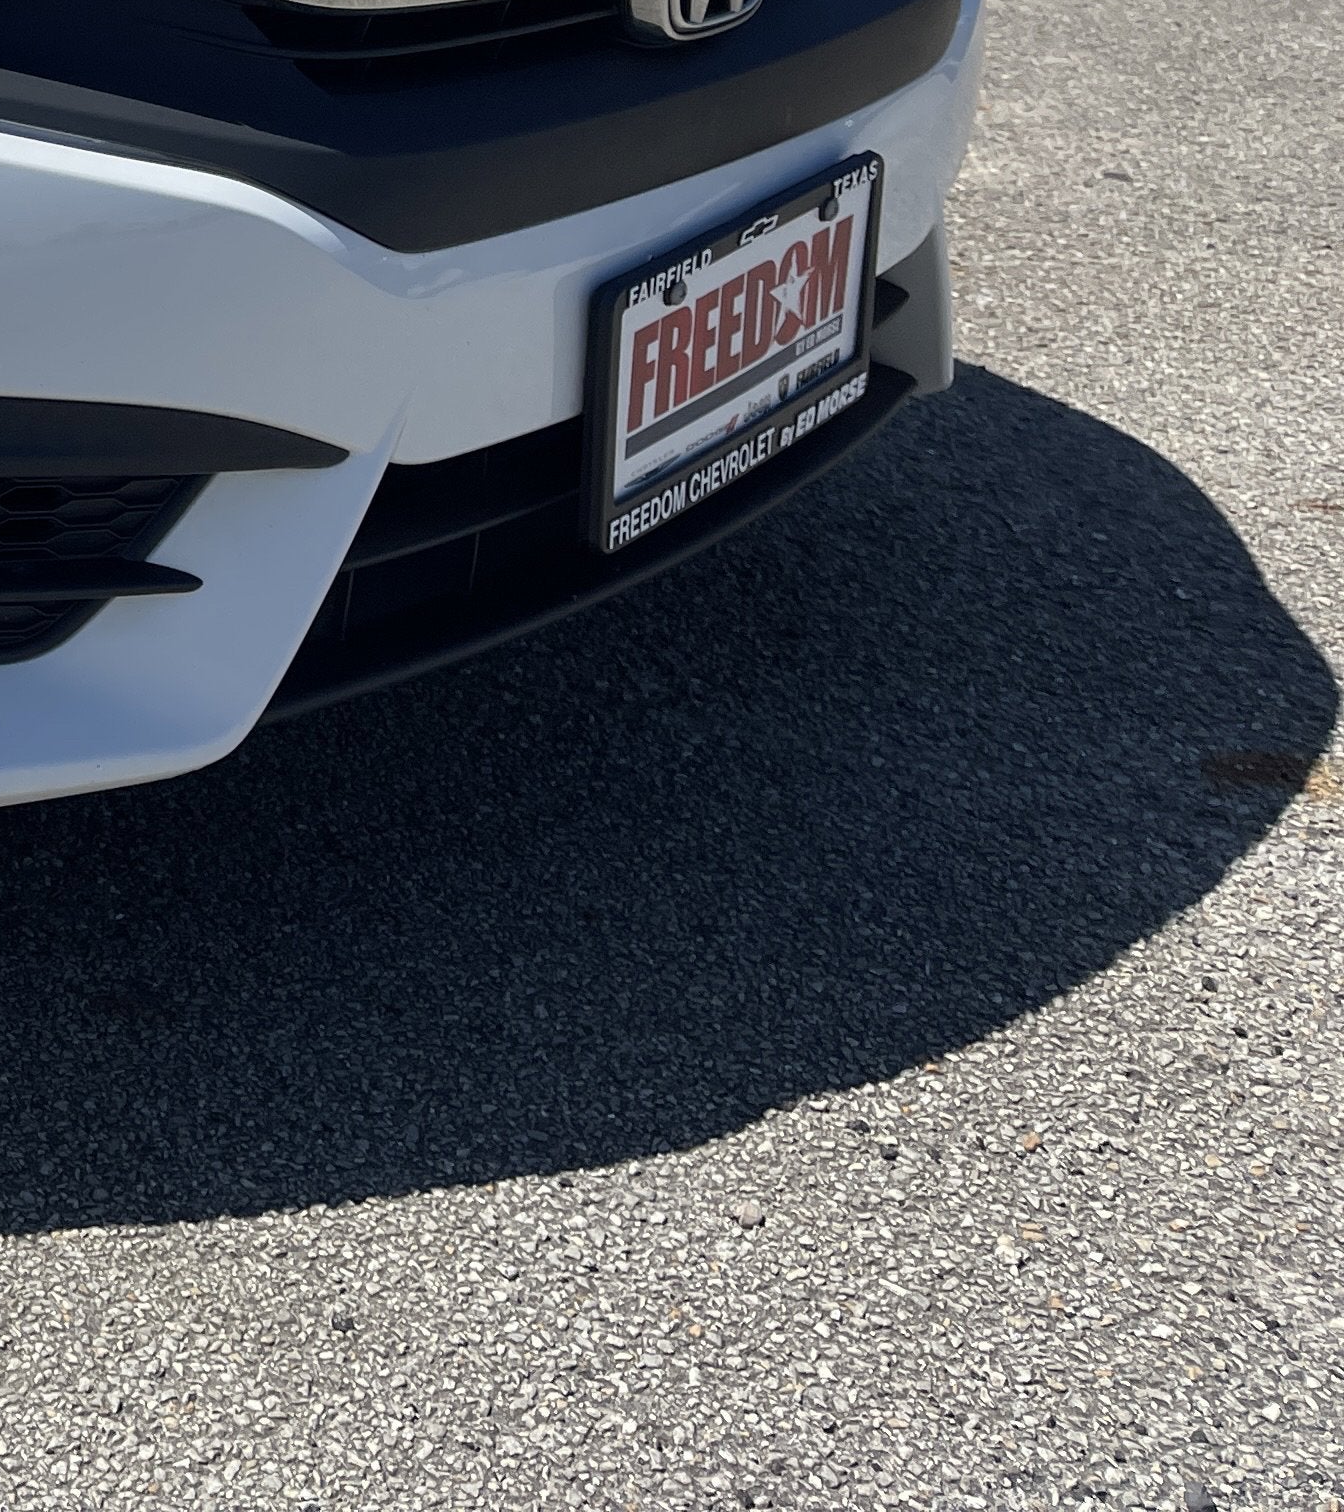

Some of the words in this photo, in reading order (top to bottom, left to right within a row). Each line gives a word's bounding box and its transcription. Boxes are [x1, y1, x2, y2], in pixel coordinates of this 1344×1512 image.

[833, 160, 878, 199] TEXAS
[629, 248, 713, 309] FAIRFIELD
[609, 481, 686, 550] FREEDOM
[689, 427, 775, 503] CHEVROLET
[795, 406, 817, 438] ED
[817, 372, 868, 425] MORSE
